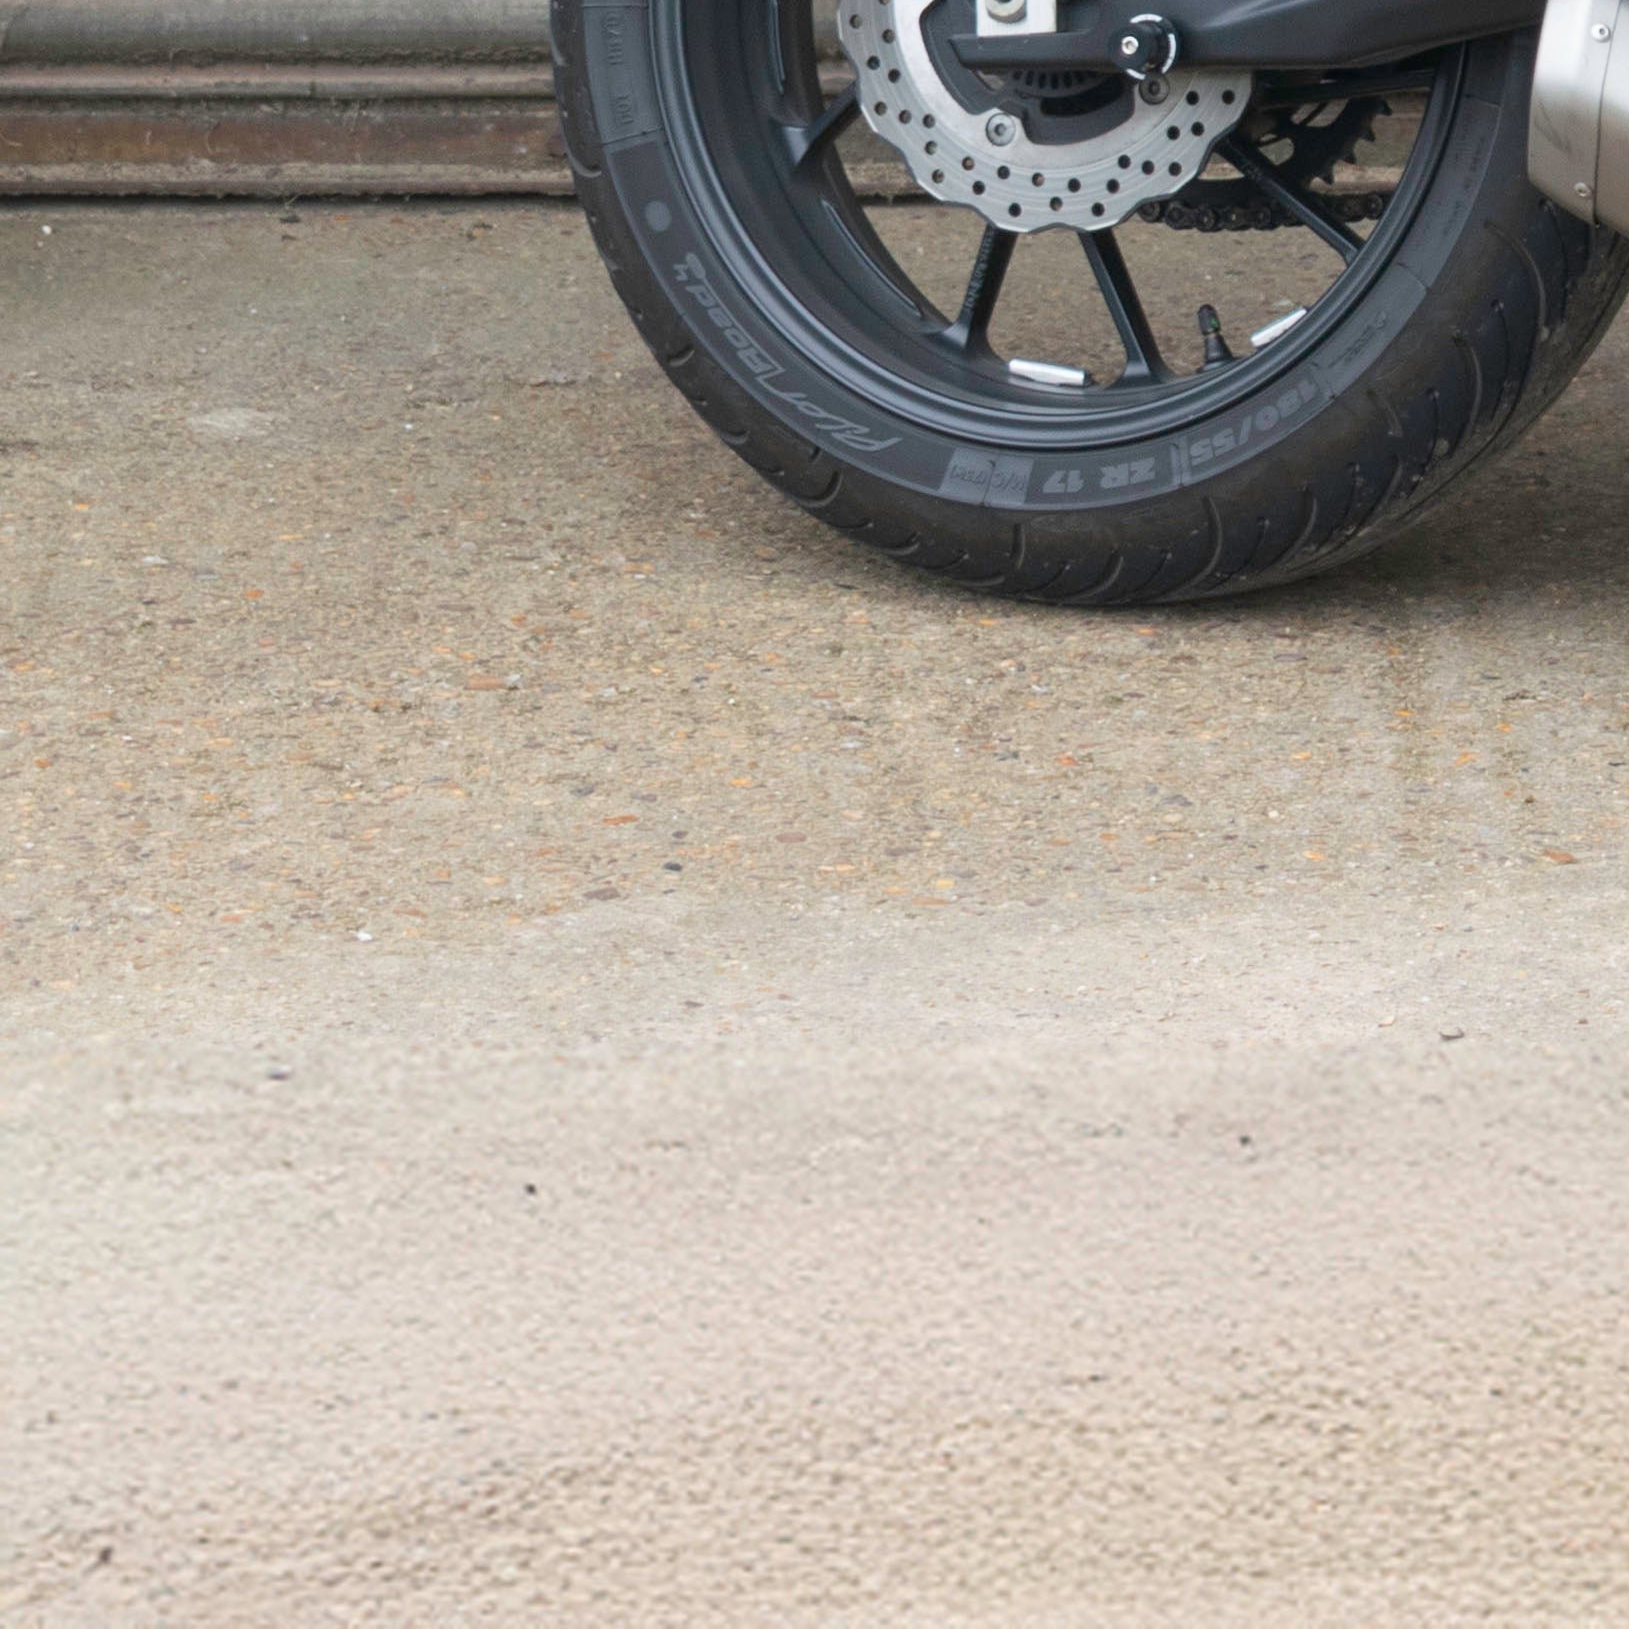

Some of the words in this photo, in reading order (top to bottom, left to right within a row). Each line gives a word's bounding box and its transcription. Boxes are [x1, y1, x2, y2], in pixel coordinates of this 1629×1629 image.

[1188, 377, 1319, 467] 180/55
[1041, 469, 1086, 493] 17
[1100, 456, 1157, 489] ZR
